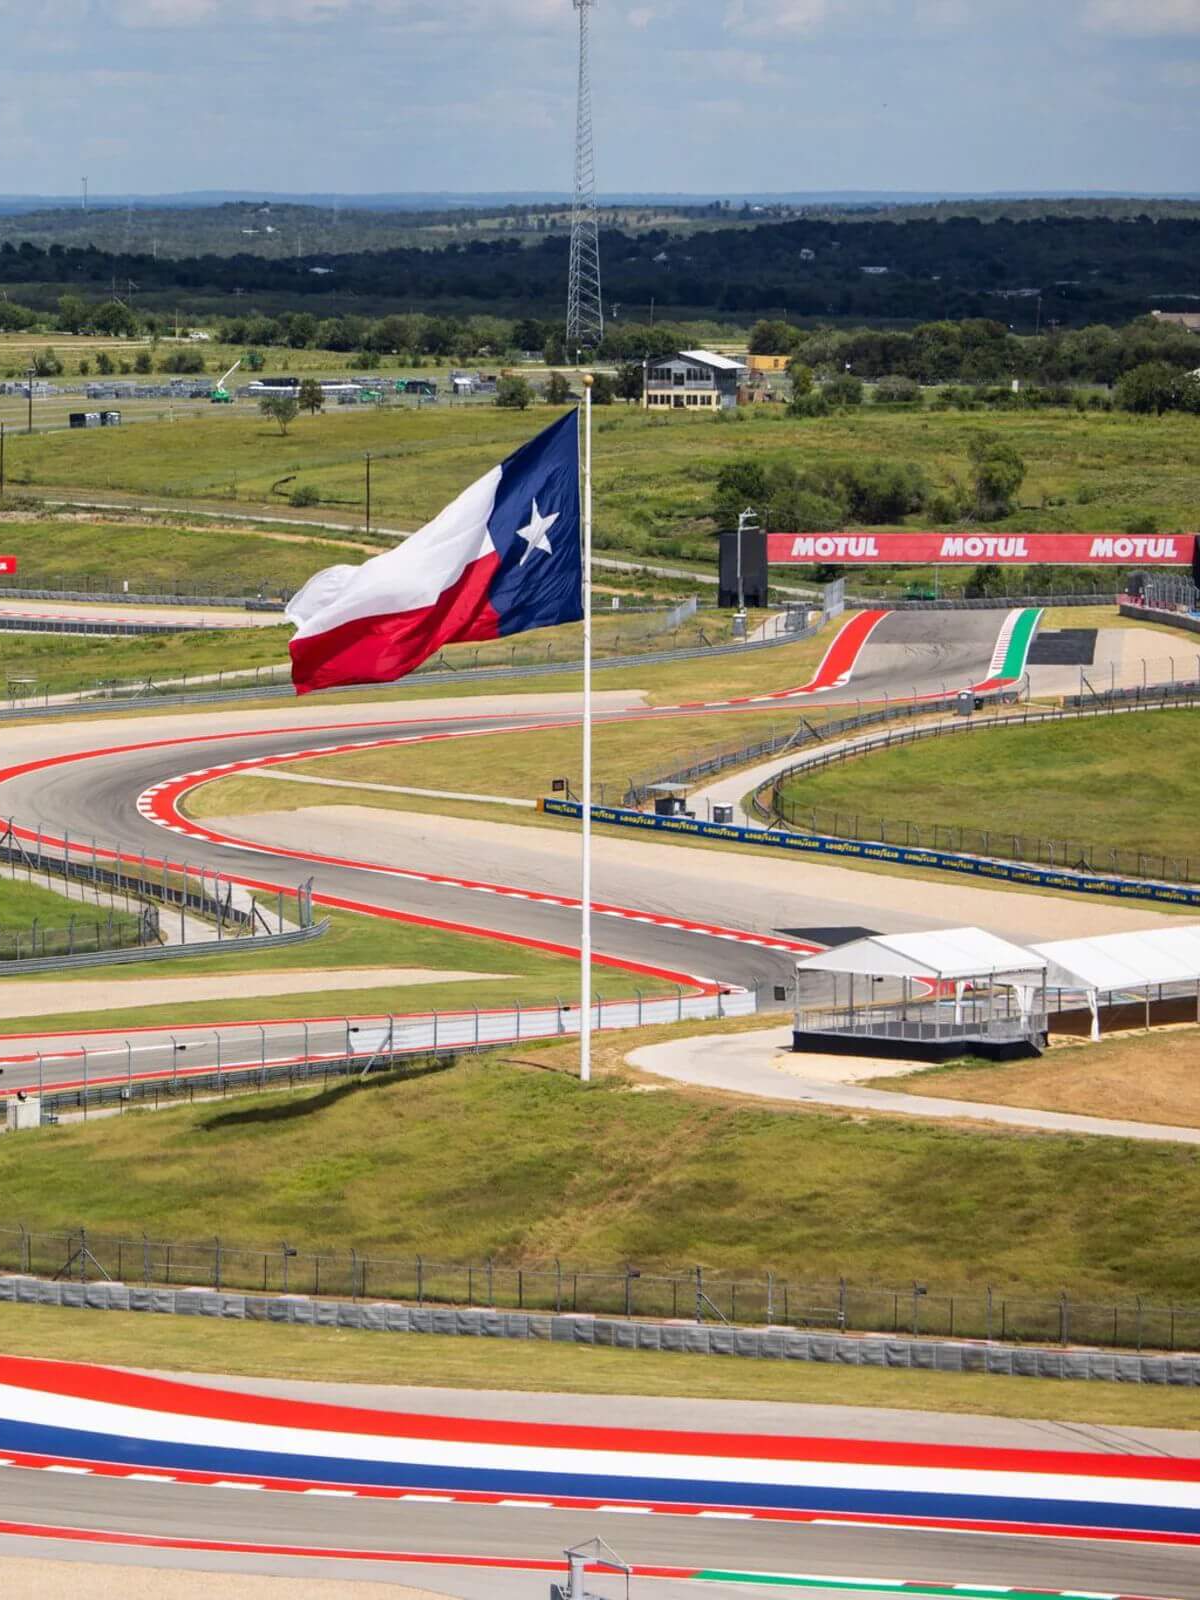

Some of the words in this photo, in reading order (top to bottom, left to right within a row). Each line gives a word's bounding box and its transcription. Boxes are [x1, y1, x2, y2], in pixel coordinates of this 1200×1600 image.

[791, 537, 879, 557] MOTUL
[940, 537, 1028, 557] MOTUL
[1089, 537, 1178, 558] MOTUL
